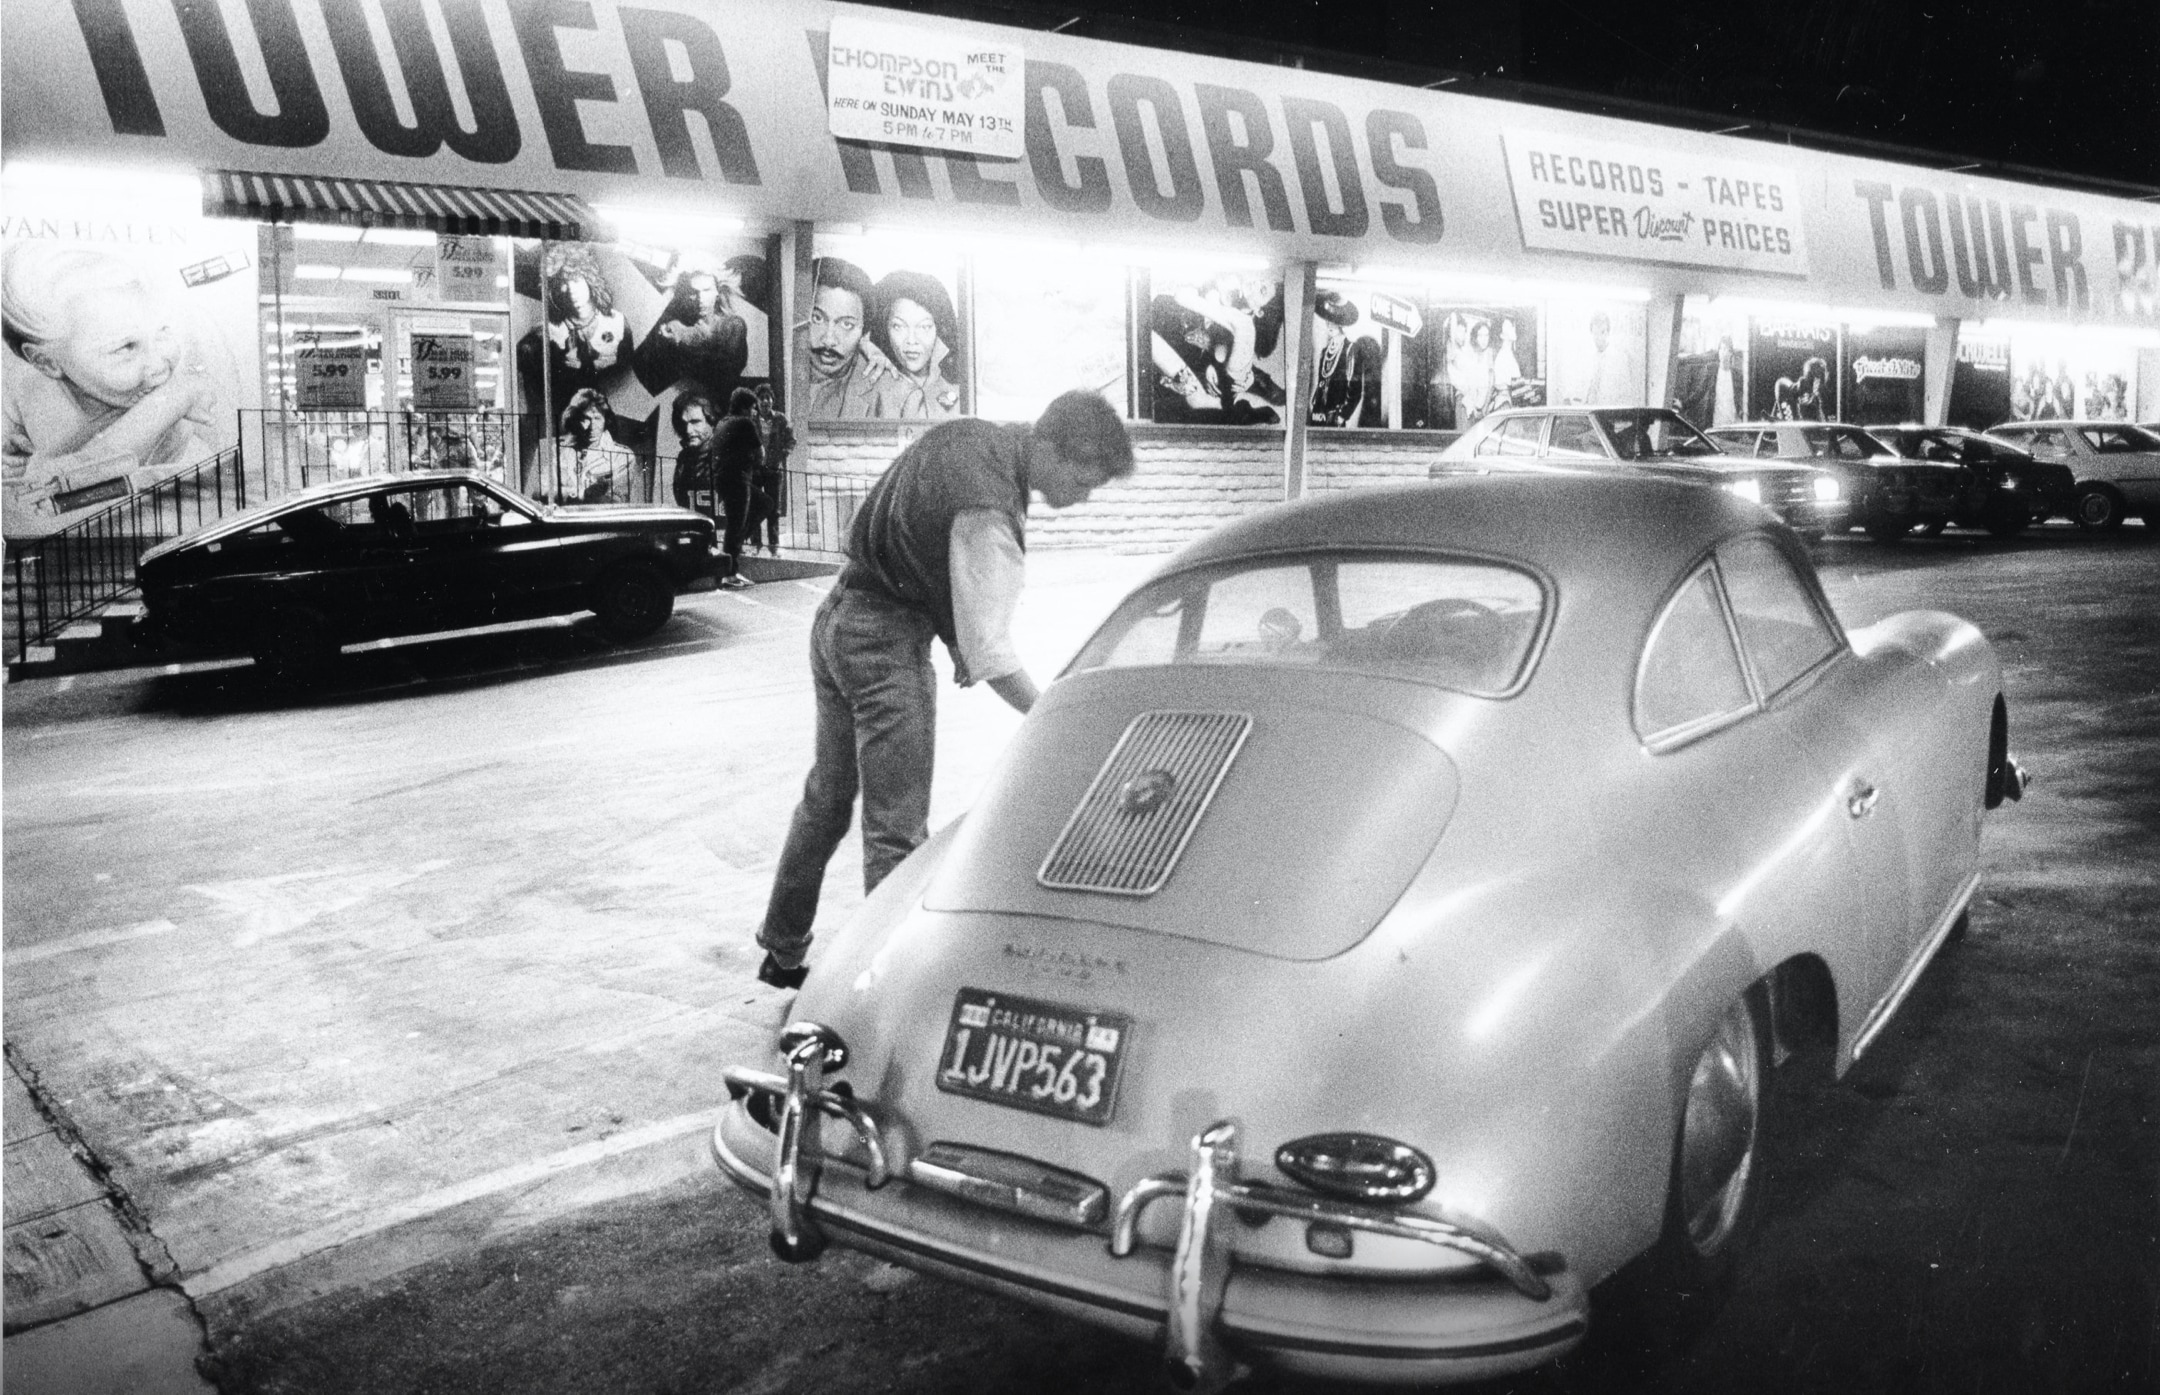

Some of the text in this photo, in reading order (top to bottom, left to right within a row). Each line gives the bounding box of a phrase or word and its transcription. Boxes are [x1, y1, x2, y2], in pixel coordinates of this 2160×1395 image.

[967, 53, 1007, 65] MEET
[986, 66, 1006, 74] THE
[834, 97, 860, 110] HERE
[863, 99, 877, 111] ON
[881, 102, 937, 122] SUNDAY
[943, 111, 974, 128] MAY
[883, 121, 894, 135] 5
[897, 122, 918, 137] PM
[935, 128, 946, 141] 7
[951, 129, 972, 144] PM
[1528, 151, 1664, 197] RECORDS
[1702, 175, 1785, 212] TAPES
[1539, 199, 1791, 255] SUPER Discount PRICES
[1853, 179, 2090, 311] TOWER
[312, 364, 348, 377] 5.99
[428, 367, 461, 379] 5.99
[943, 1029, 1107, 1111] 1JVP563
